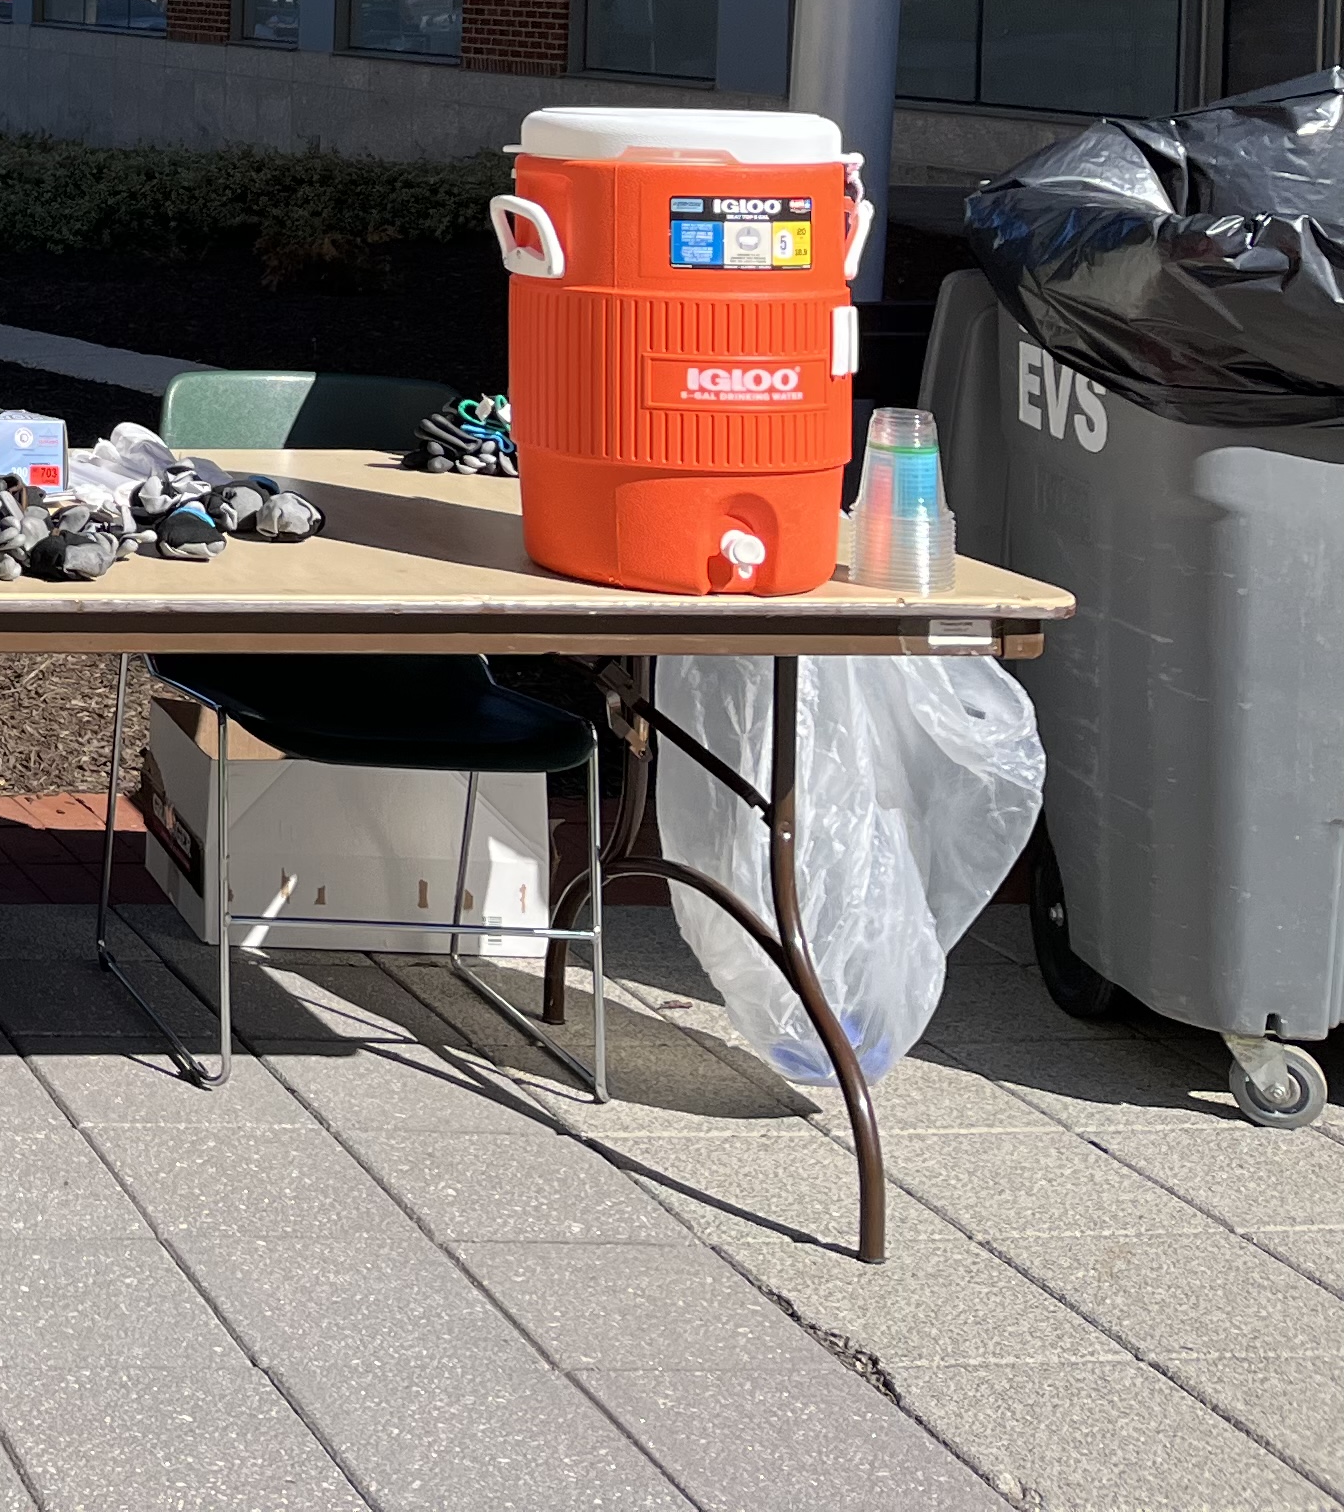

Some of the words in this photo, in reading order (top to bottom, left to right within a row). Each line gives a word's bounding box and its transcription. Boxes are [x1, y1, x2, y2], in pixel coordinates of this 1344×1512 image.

[713, 199, 781, 214] IGLOO
[779, 235, 787, 250] 5
[794, 248, 808, 256] 18.9
[687, 368, 798, 391] IGLOO
[719, 392, 770, 401] DRINKING
[772, 392, 803, 400] WATER
[1019, 341, 1108, 453] EVS
[41, 467, 57, 478] 703
